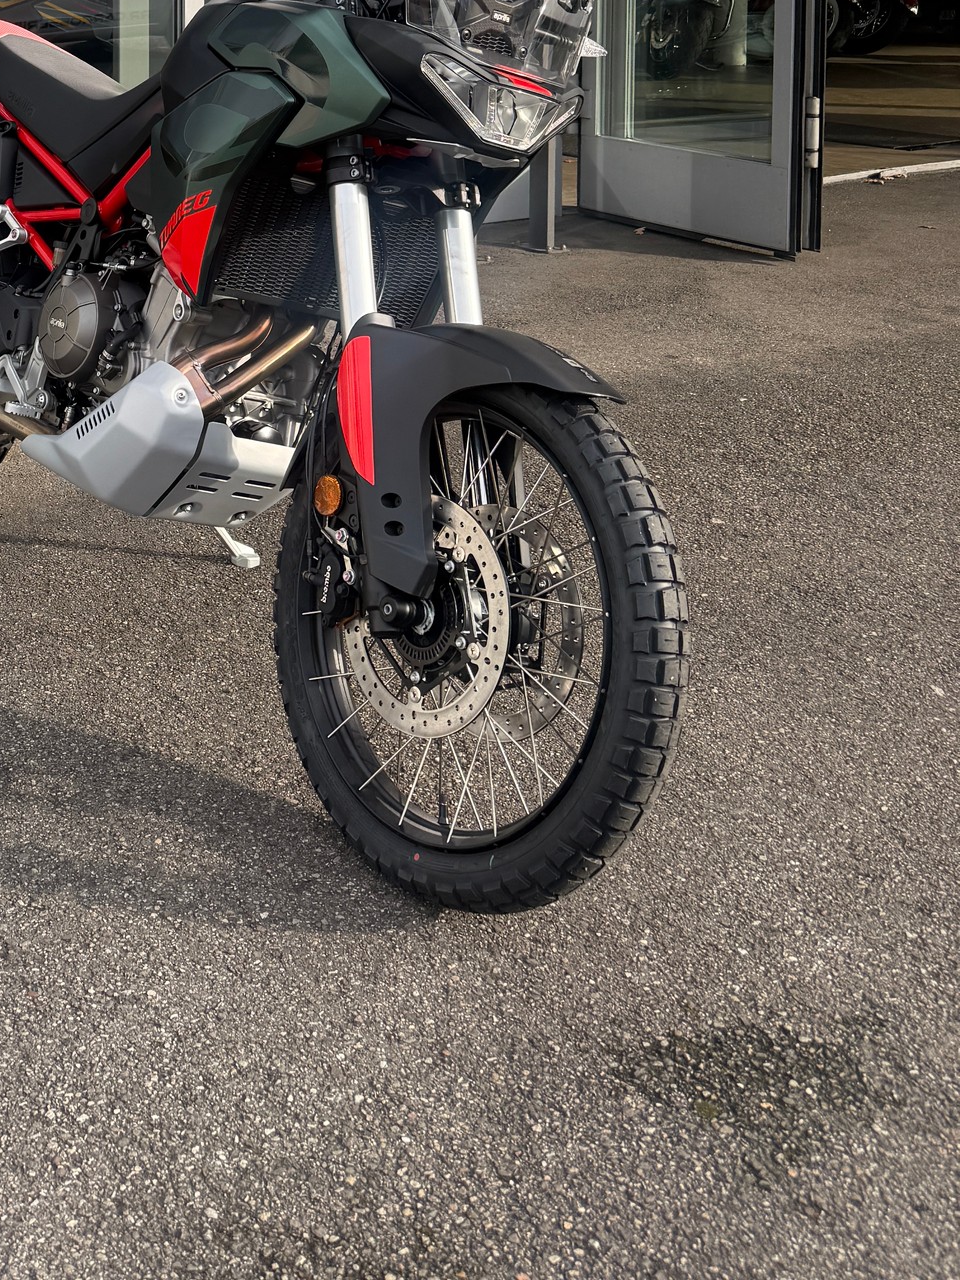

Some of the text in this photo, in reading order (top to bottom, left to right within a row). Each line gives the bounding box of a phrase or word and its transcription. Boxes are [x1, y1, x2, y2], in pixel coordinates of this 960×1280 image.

[493, 12, 510, 23] aprilia
[49, 317, 65, 329] aprilia
[320, 565, 332, 604] brembo
